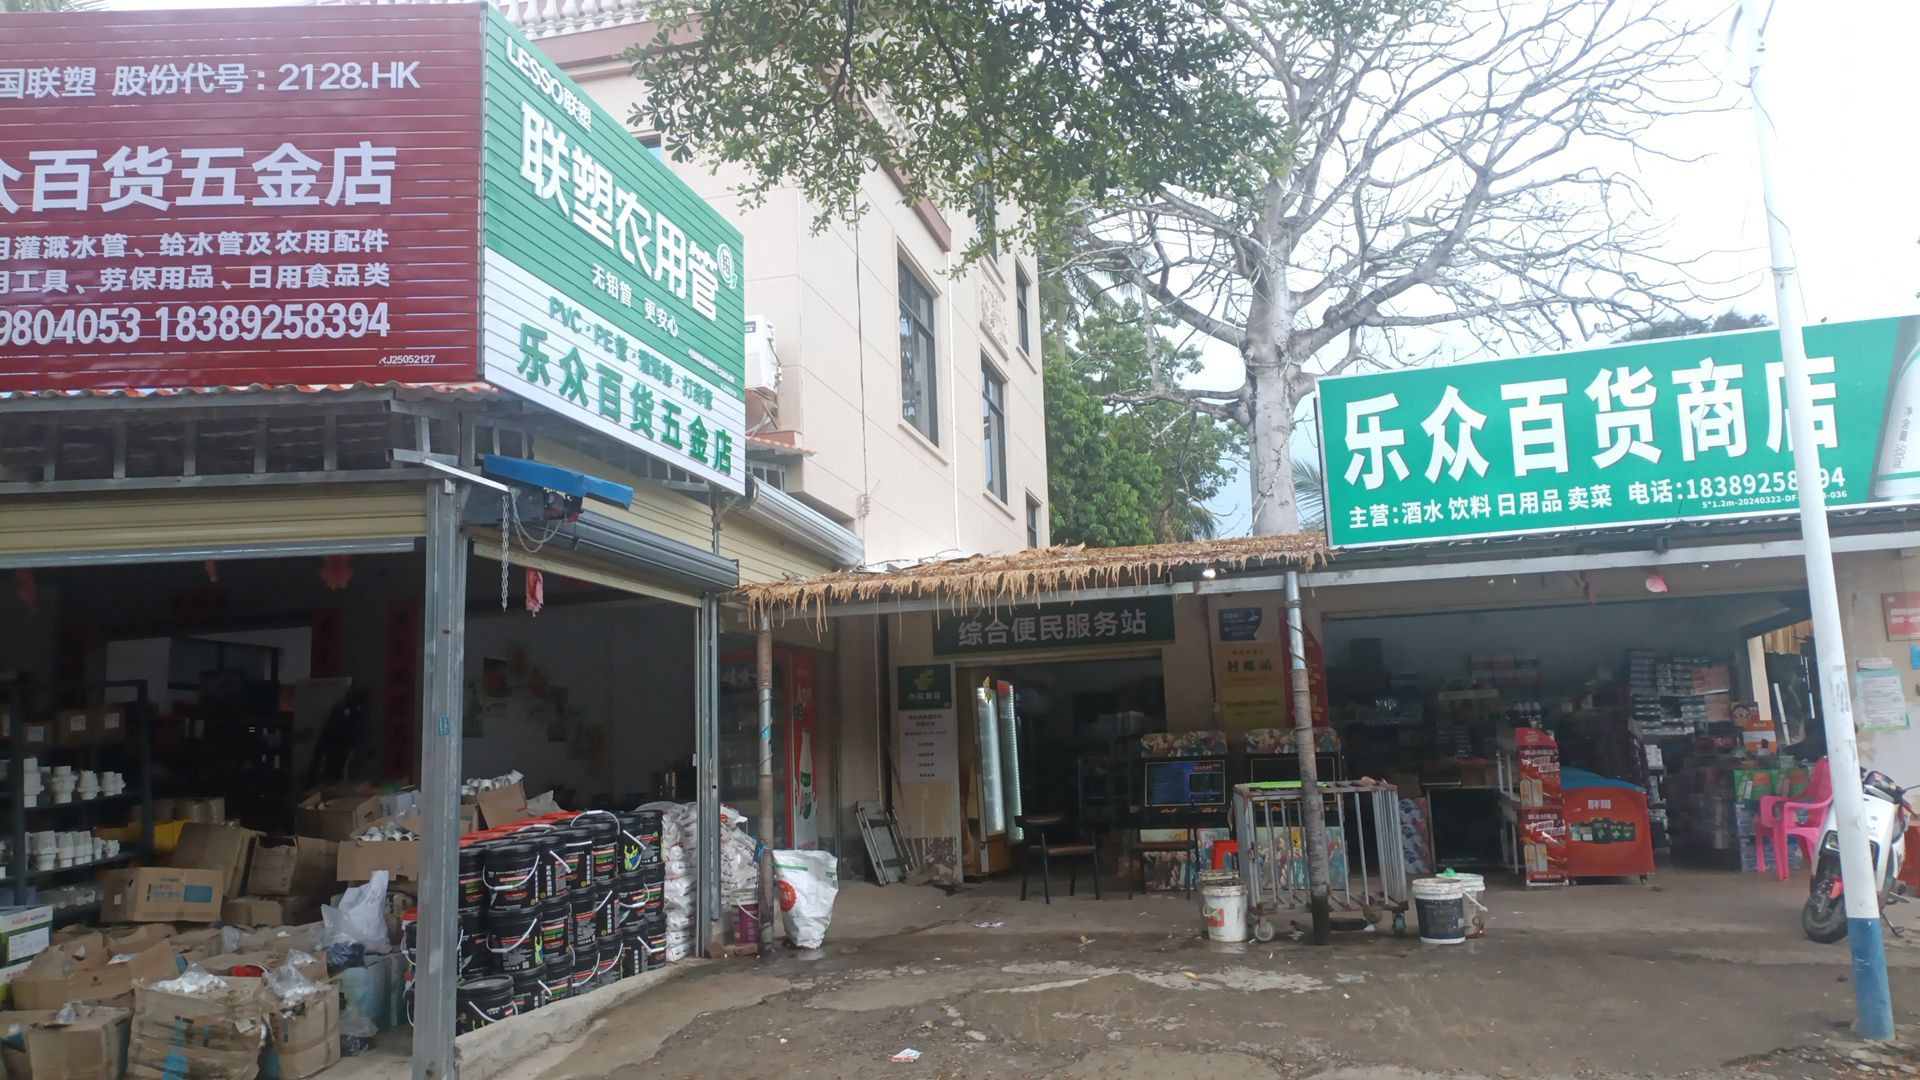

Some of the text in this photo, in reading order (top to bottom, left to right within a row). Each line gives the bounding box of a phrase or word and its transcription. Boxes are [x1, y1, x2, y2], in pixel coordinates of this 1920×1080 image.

[520, 101, 718, 322] 联塑农用管
[0, 302, 390, 346] 9804053 18389258394
[591, 262, 679, 338] 无铅管 更安心
[516, 322, 733, 476] 乐众百货五金店
[1343, 354, 1839, 492] 乐众百货商店
[1448, 496, 1492, 520] 饮料
[1497, 490, 1563, 517] 日用品
[1567, 483, 1613, 511] 卖菜
[1628, 466, 1847, 505] 电话:1838925894
[957, 611, 1148, 648] 综合便民服务站
